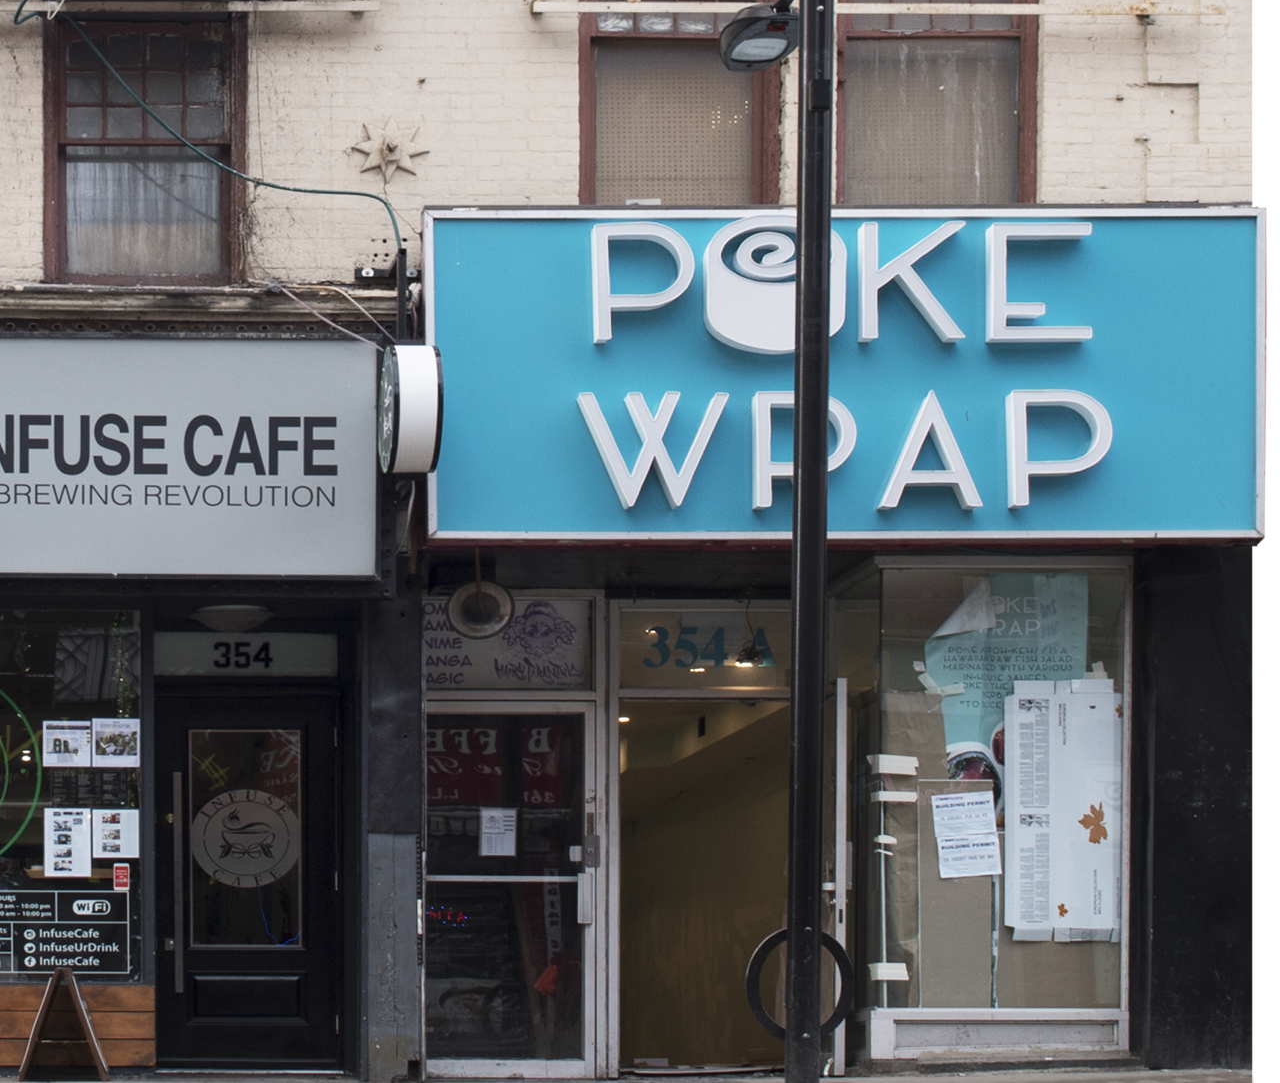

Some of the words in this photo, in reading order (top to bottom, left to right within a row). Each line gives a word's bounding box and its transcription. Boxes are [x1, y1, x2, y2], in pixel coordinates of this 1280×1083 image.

[591, 215, 1093, 354] POKE
[183, 413, 338, 477] CAFE
[143, 483, 337, 507] REVOLUTION
[978, 619, 1041, 636] RAP
[425, 637, 463, 649] NIME
[642, 626, 728, 668] 354
[213, 641, 273, 668] 354
[1041, 655, 1073, 664] SALAD
[426, 655, 472, 667] ANGA
[999, 664, 1026, 672] WITH
[1028, 664, 1073, 672] VARIOUS
[426, 673, 464, 684] AGIC
[39, 928, 100, 939] InfuseCafe
[39, 942, 120, 953] InfuseUrDrink
[39, 956, 100, 966] InfuseCafe
